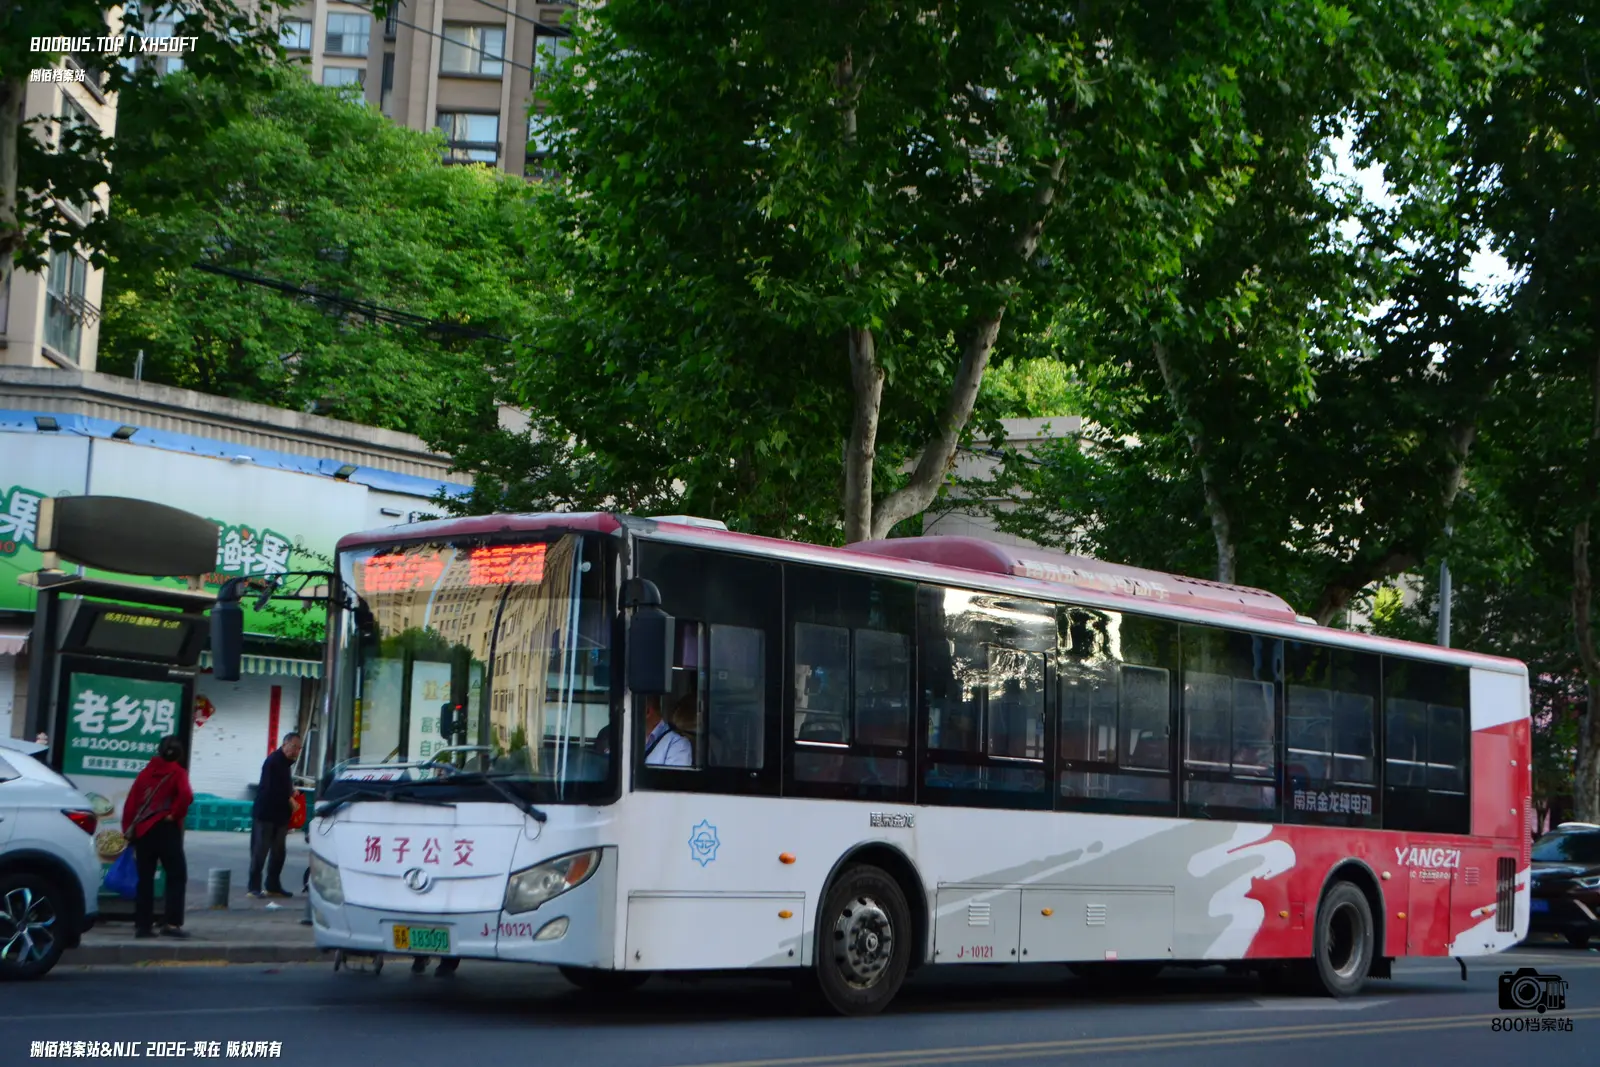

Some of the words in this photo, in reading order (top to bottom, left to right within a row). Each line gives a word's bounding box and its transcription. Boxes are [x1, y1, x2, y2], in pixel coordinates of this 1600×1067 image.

[216, 525, 288, 585] 鲜果
[73, 689, 176, 738] 老乡鸡
[1294, 790, 1372, 816] 南京金龙纯电动
[364, 835, 475, 867] 扬子公交
[1395, 846, 1461, 868] YANGZI
[481, 922, 533, 937] J-10121
[957, 945, 993, 959] J-10121
